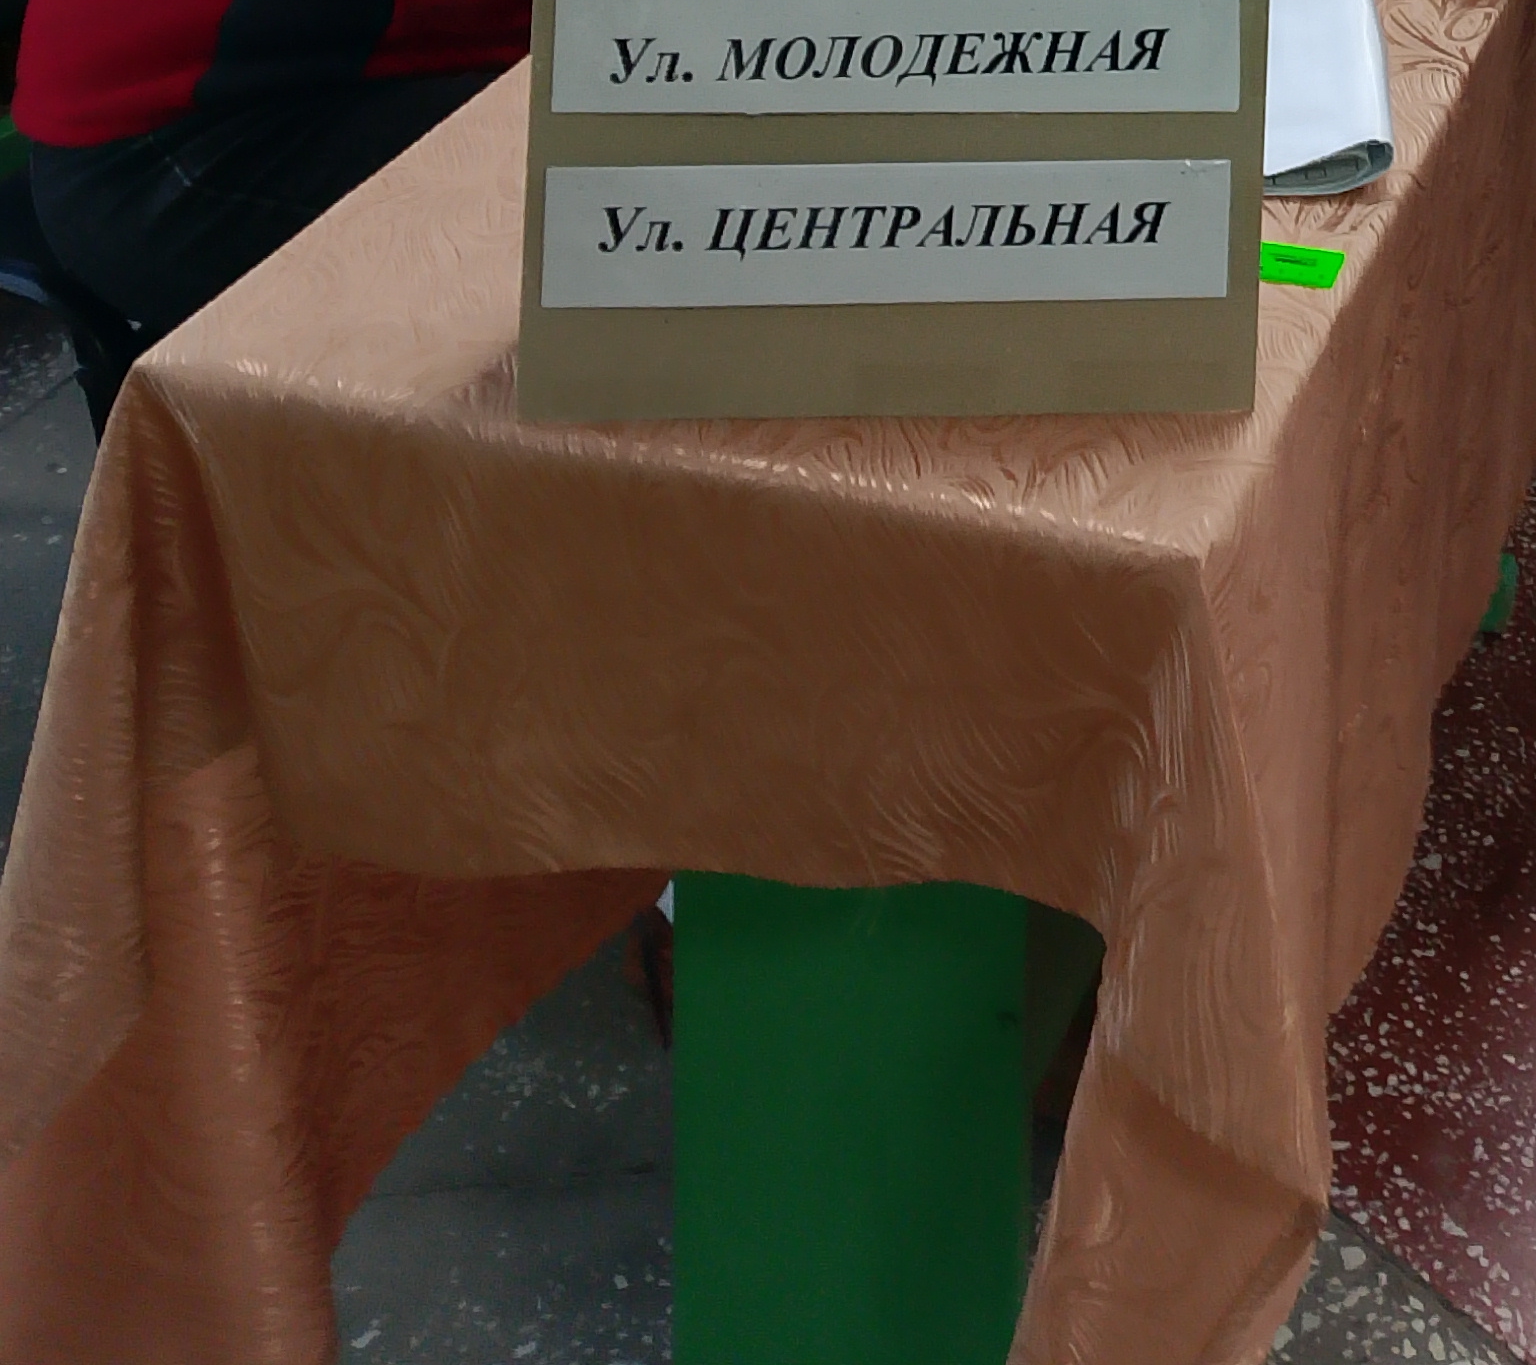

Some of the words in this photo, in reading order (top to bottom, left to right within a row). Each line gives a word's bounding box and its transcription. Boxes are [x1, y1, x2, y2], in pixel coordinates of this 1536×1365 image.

[610, 36, 694, 85] Ул.
[716, 27, 1171, 88] МОЛОДЕЖНАЯ
[598, 206, 684, 253] Ул.
[705, 201, 1172, 262] ЦЕНТРАЛЬНАЯ
